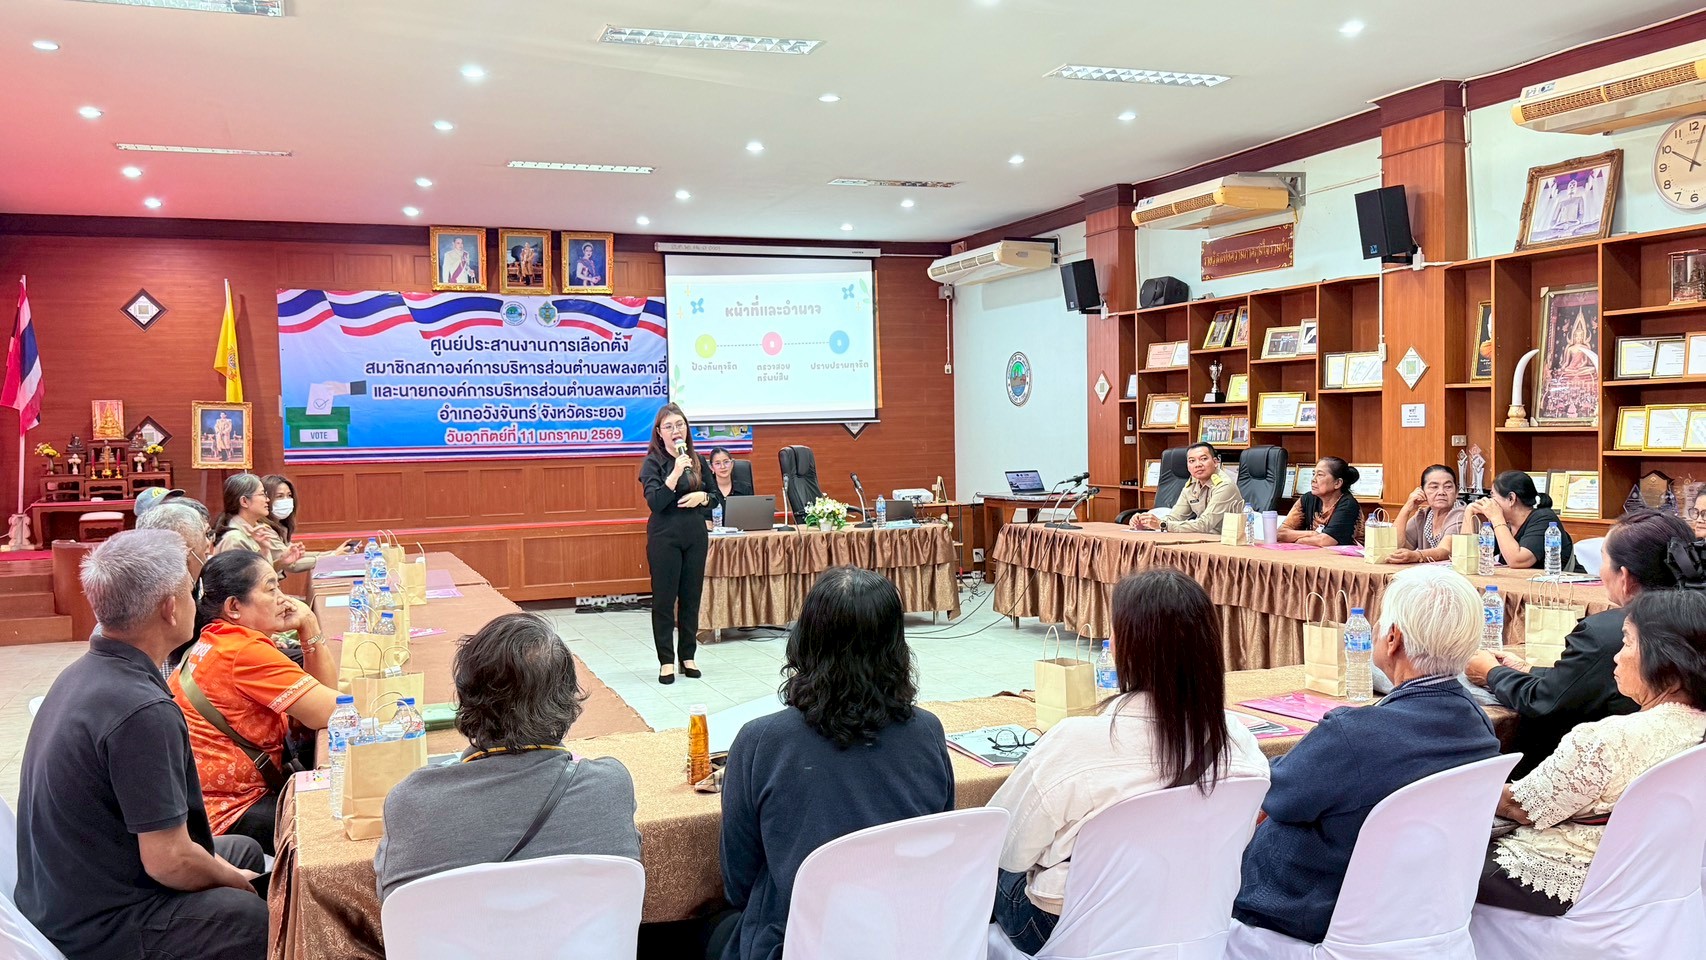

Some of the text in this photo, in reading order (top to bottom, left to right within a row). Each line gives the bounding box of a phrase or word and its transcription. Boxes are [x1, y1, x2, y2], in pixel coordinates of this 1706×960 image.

[1689, 121, 1700, 131] 12
[1674, 129, 1682, 139] 11
[1661, 145, 1672, 155] 10
[1658, 163, 1668, 173] 9
[1663, 179, 1672, 190] 8
[1674, 192, 1682, 202] 7
[1690, 193, 1699, 203] 6
[724, 295, 822, 318] หน้าที่และอำนาจ
[430, 332, 629, 356] ศูนย์ประสานงานการเลือกตั้ง
[365, 355, 668, 375] สมาชิกสภาองค์การบริหารส่วนตำบลพลงตาเอี่
[691, 361, 738, 374] ป้องกันทุจริต
[756, 363, 791, 371] ตรวจสอบ
[810, 360, 869, 372] ปราบปรามทุจริต
[757, 372, 789, 382] ทรัพย์สิน
[374, 377, 669, 398] และนายกองค์การบริหารส่วนตำบลพลงตาเอี่ย
[440, 404, 624, 420] อำเภอวังจันทร์ จังหวัดระยอง
[310, 431, 328, 440] VOTE
[446, 424, 622, 443] วันอาทิตย์ที่ 11 มกราคม 2569
